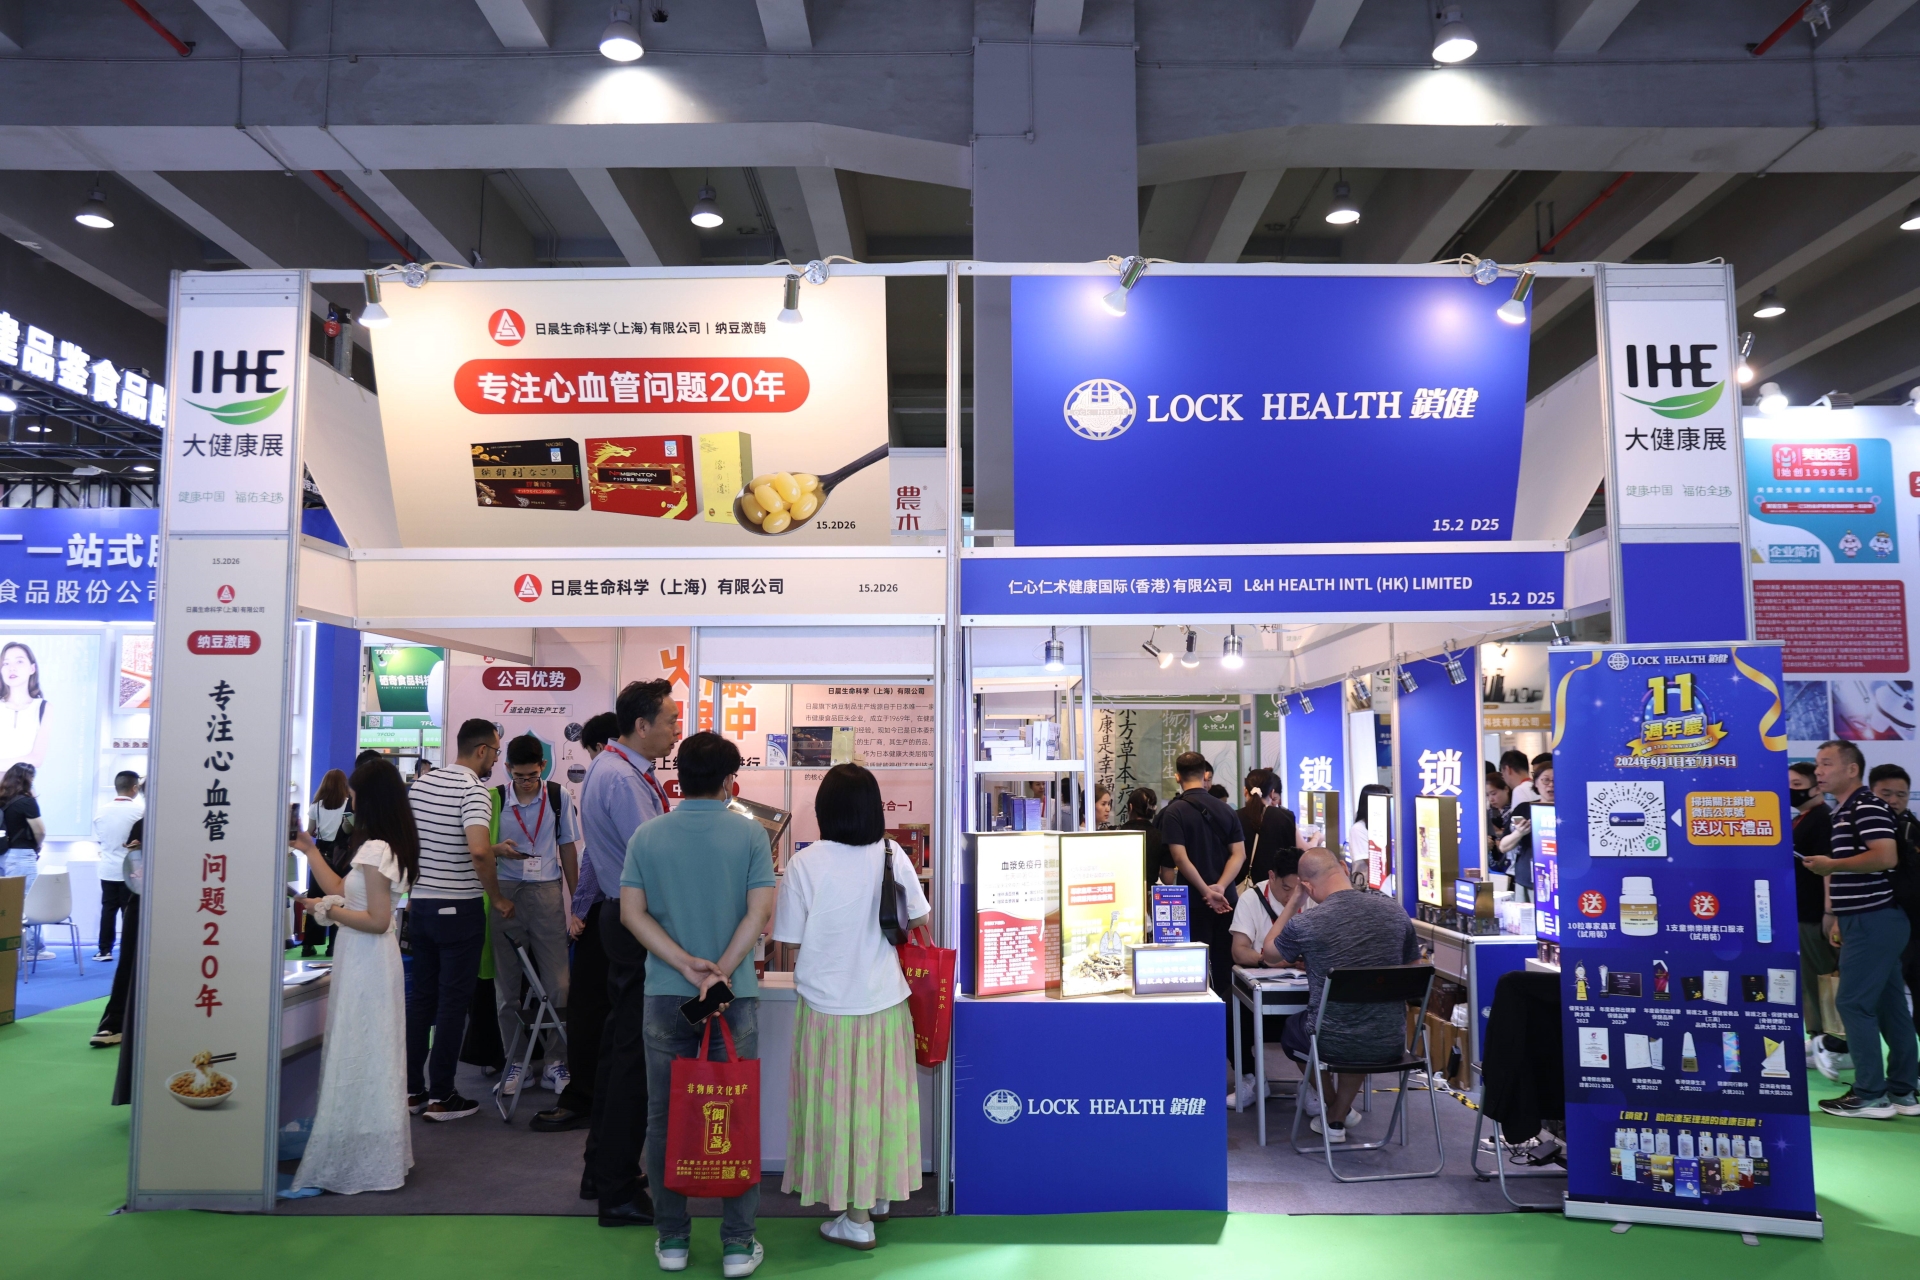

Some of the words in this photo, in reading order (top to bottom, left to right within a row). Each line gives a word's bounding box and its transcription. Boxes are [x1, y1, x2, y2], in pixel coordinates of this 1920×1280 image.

[535, 321, 701, 335] 日晨生命科学（上海）有限公司
[715, 321, 767, 335] 纳豆激酶
[191, 349, 286, 394] IHE
[1626, 344, 1719, 388] IHE
[477, 369, 787, 405] 专注心血管问题20年
[1146, 393, 1244, 424] LOCK
[1261, 391, 1404, 422] HEALTH
[1408, 386, 1480, 420] 鎖健
[182, 432, 285, 458] 大健康展
[1625, 426, 1728, 452] 大健康展
[178, 490, 226, 504] 健康中国
[235, 489, 285, 504] 福佑全球
[1625, 484, 1674, 498] 健康中国
[1682, 483, 1733, 498] 福佑全球
[816, 520, 856, 530] 15.2D26
[1432, 518, 1464, 532] 15.2
[1470, 517, 1500, 531] D25
[212, 557, 241, 566] 15.2D26
[550, 578, 785, 596] 日晨生命科学（上海）有限公司
[858, 583, 899, 594] 15.2D26
[1008, 577, 1233, 596] 仁心仁术健康国际（香港）有限公司
[1243, 578, 1275, 592] L&H
[1278, 577, 1337, 592] HEALTH
[1339, 577, 1374, 591] INTL
[1376, 576, 1410, 594] (HK)
[1413, 576, 1474, 591] LIMITED
[1489, 592, 1521, 606] 15.2
[1527, 591, 1556, 605] D25
[197, 634, 252, 649] 纳豆激酶
[1631, 656, 1660, 666] LOCK
[1664, 655, 1706, 665] HEALTH
[496, 670, 567, 689] 公司优势
[1648, 672, 1693, 716] 11
[1643, 716, 1704, 742] 週年慶
[1616, 755, 1738, 768] 2024年6月1日至7月15日
[1299, 755, 1333, 791] 锁
[1418, 748, 1463, 796] 锁
[1692, 820, 1773, 837] 送以下禮品
[1581, 892, 1604, 914] 送
[1692, 894, 1715, 917] 送
[687, 1082, 749, 1096] 非物质文化遗产
[1027, 1098, 1080, 1115] LOCK
[1089, 1098, 1166, 1115] HEALTH
[1169, 1097, 1207, 1116] 鎖健
[709, 1107, 726, 1149] 御五盏
